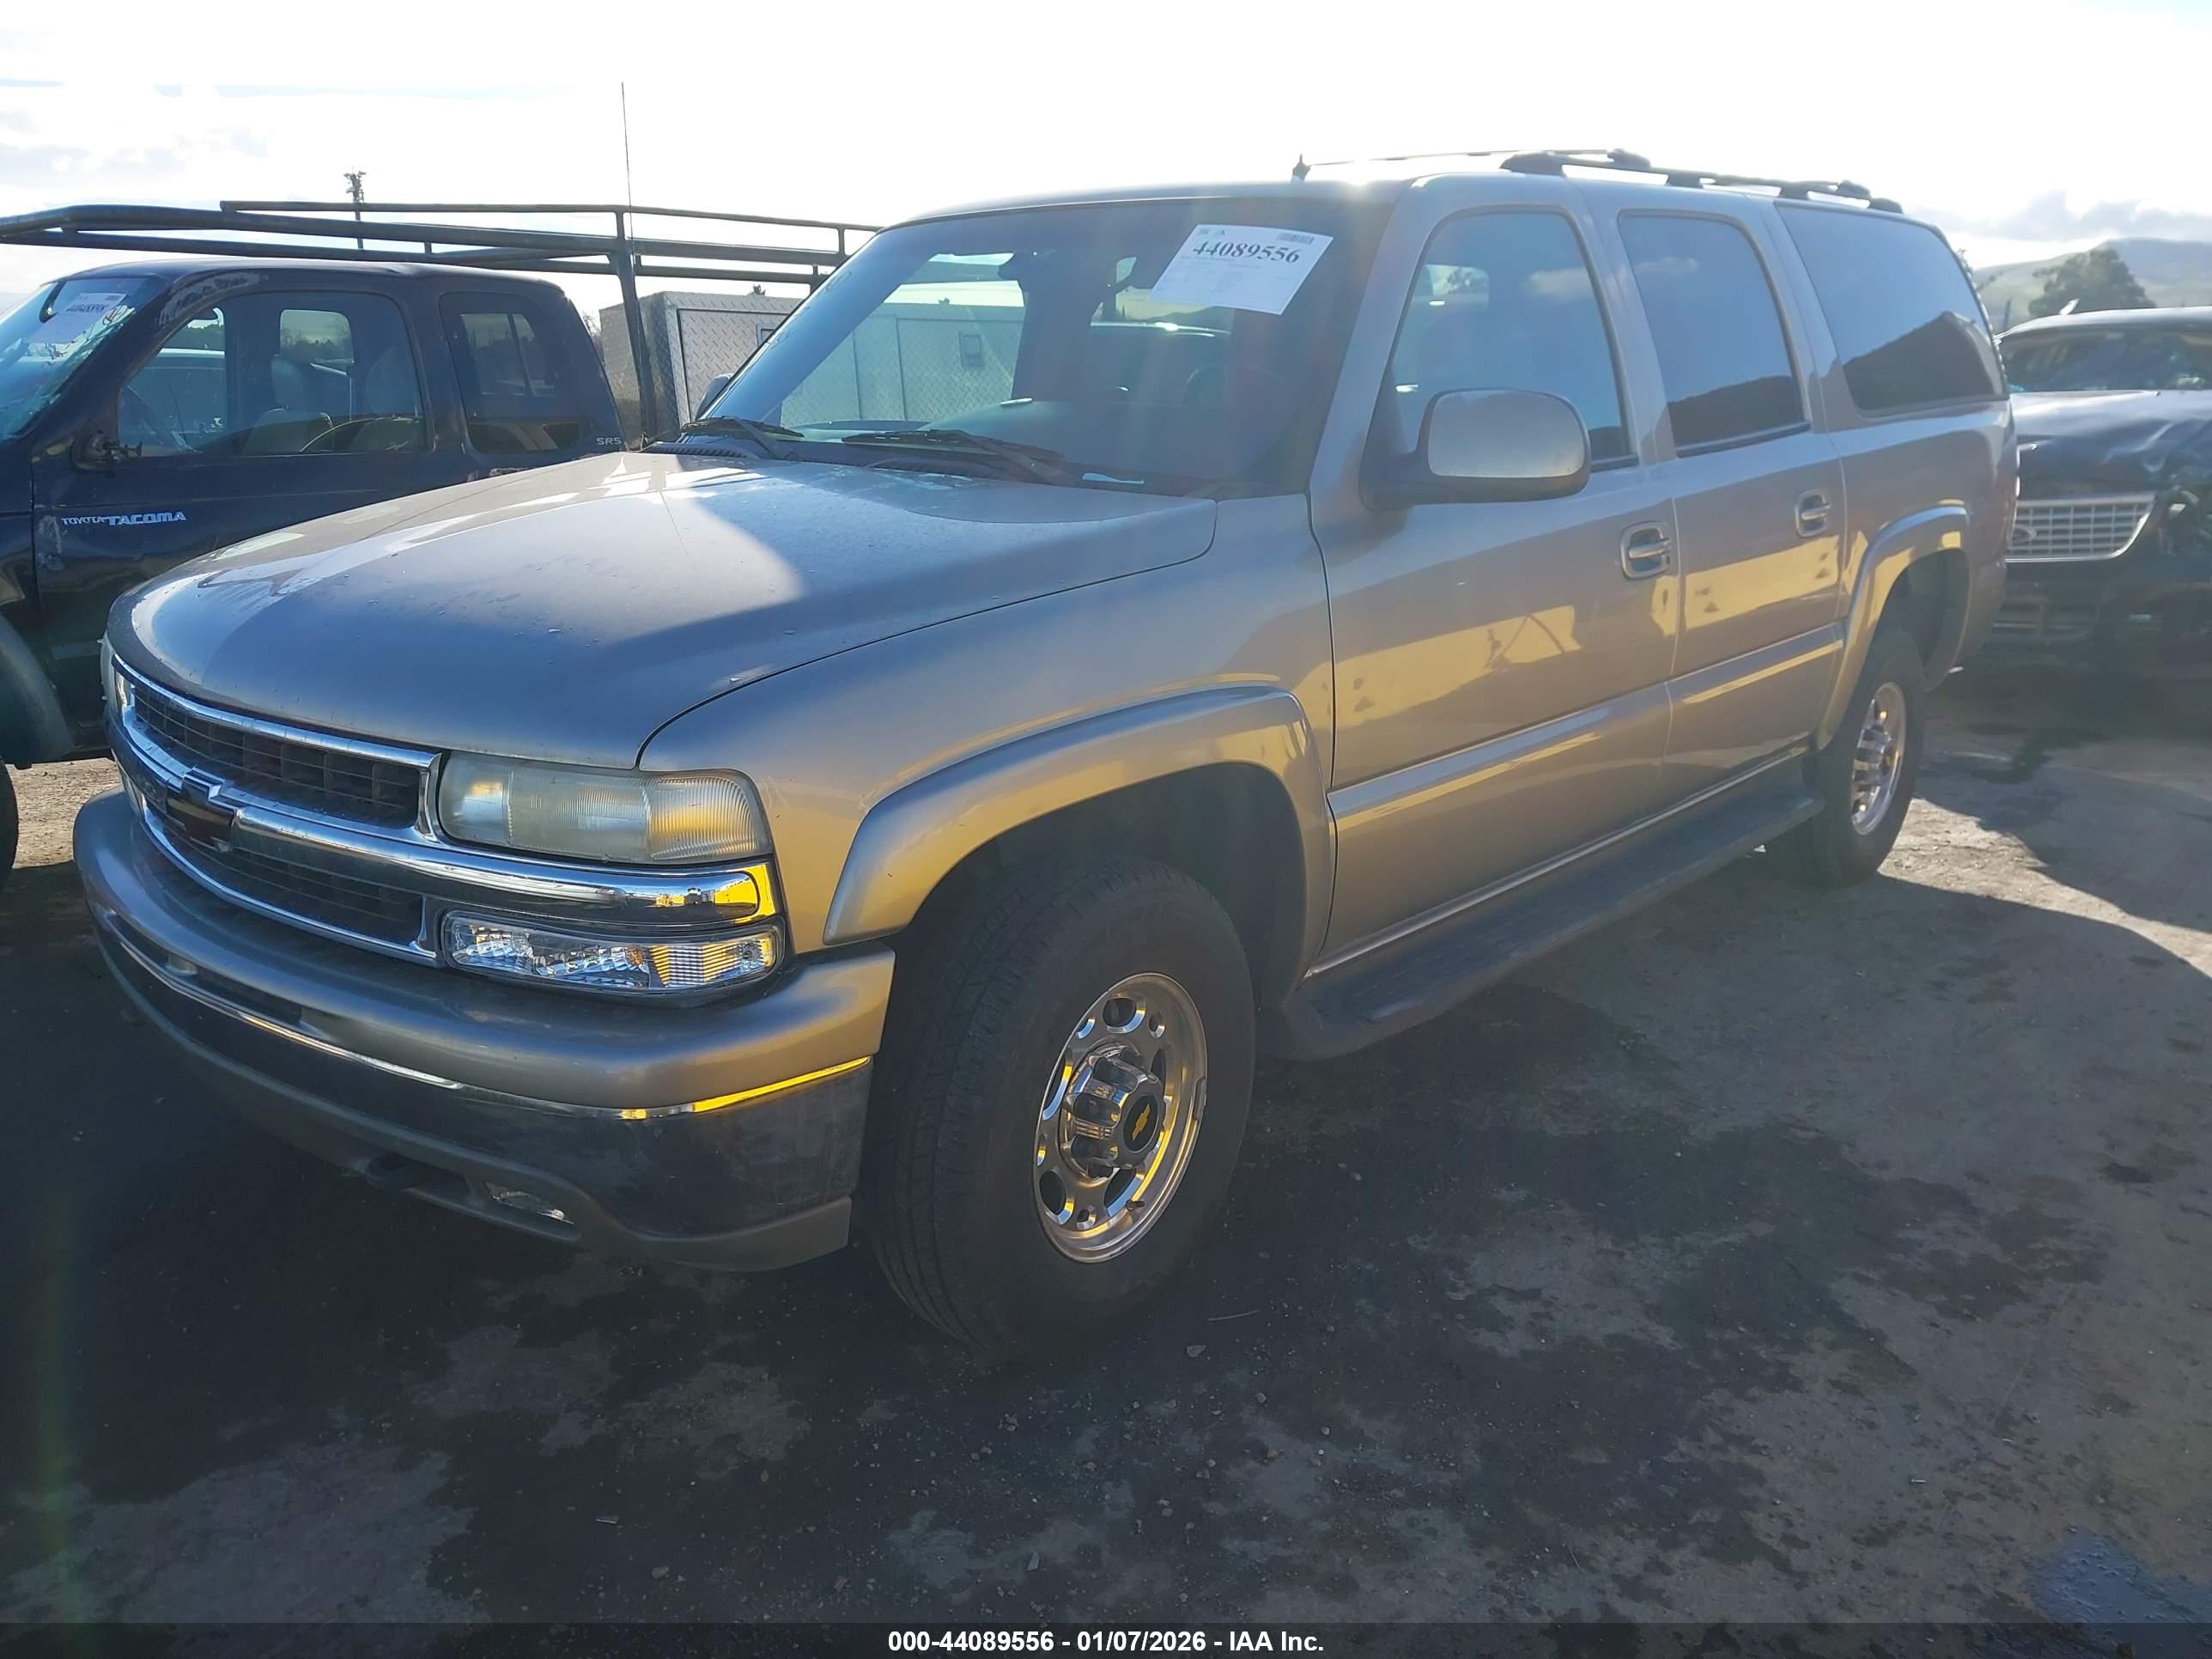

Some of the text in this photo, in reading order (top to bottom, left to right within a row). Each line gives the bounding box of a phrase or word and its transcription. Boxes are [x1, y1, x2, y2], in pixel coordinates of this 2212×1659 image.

[1193, 240, 1301, 264] 44089556
[61, 511, 186, 526] TOYOTA TACOMA
